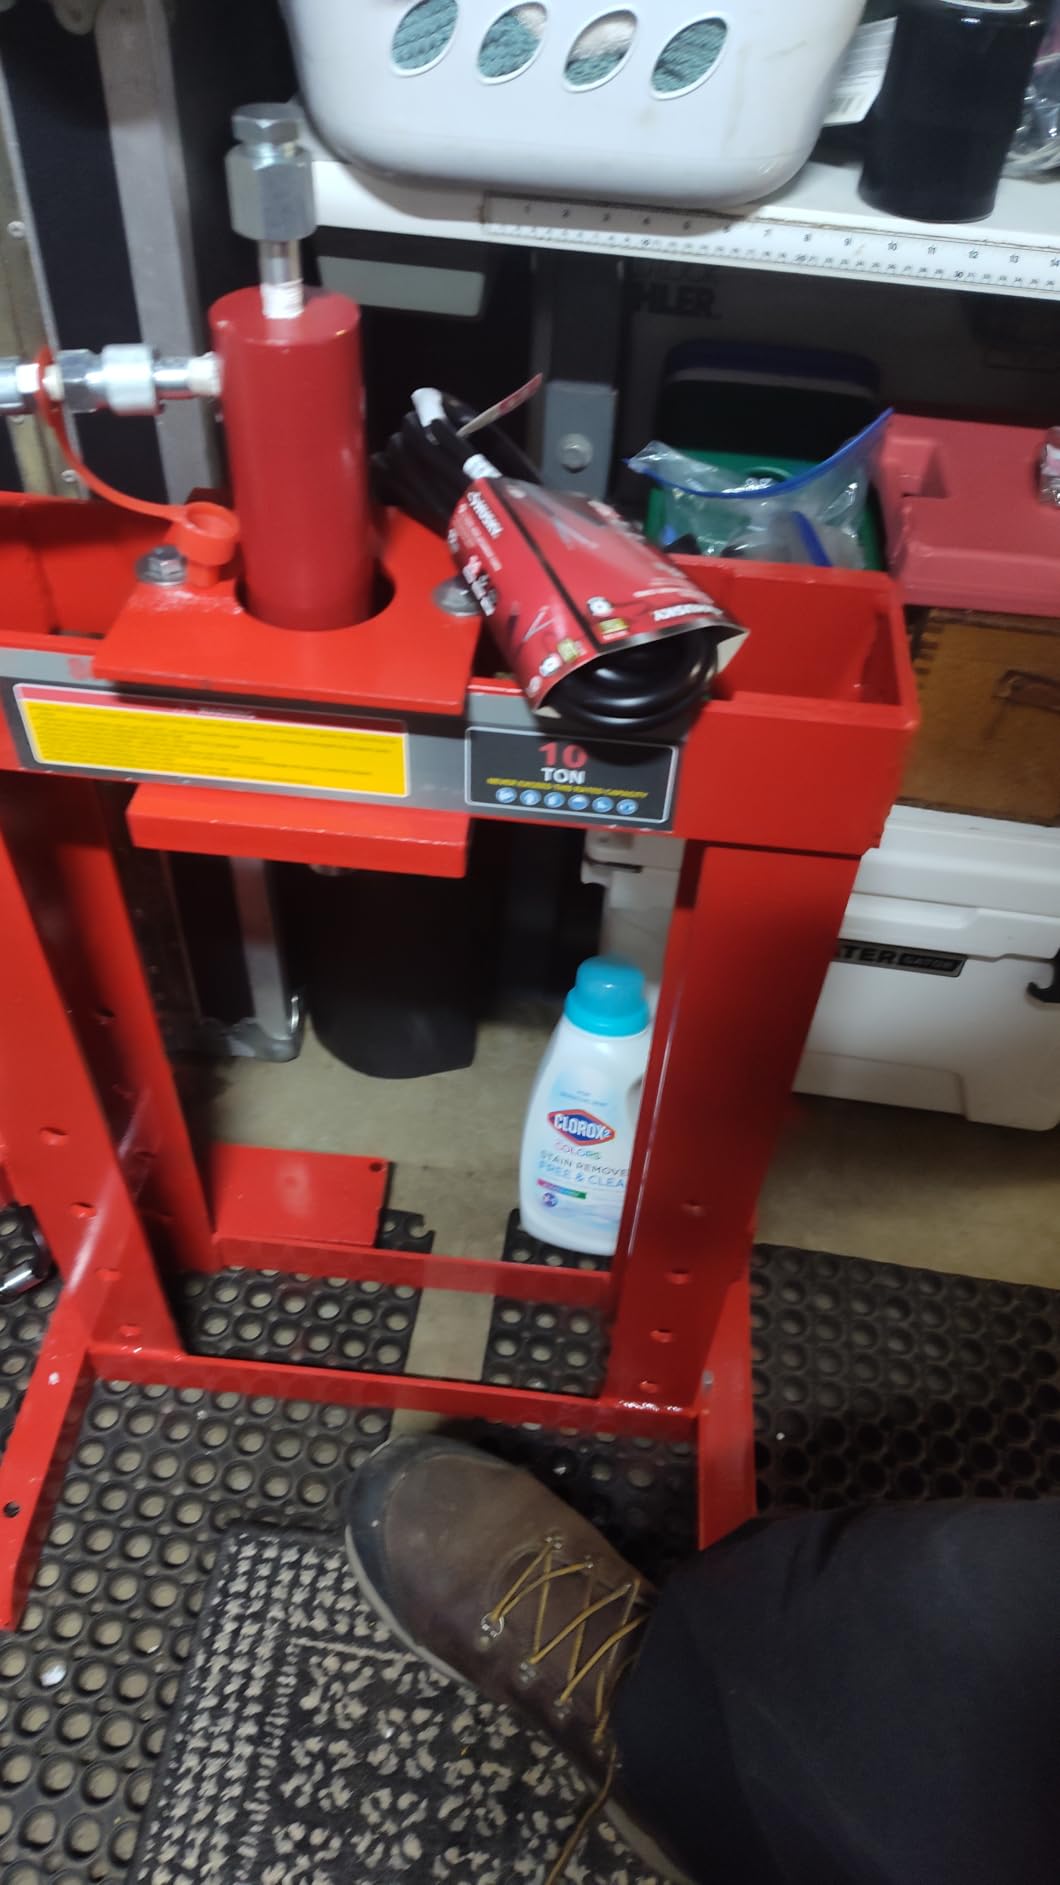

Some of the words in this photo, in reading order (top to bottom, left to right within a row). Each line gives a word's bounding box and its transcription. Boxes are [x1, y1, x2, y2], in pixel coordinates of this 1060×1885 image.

[888, 240, 898, 251] 10
[968, 249, 979, 259] 12
[538, 741, 588, 769] 10
[541, 767, 587, 785] TON
[840, 944, 897, 965] TER
[554, 1141, 601, 1160] COLORS
[540, 1149, 572, 1167] STAIN
[576, 1161, 629, 1177] REMOVE
[539, 1160, 570, 1177] FREE
[575, 1172, 585, 1183] &
[588, 1174, 625, 1189] CLEA
